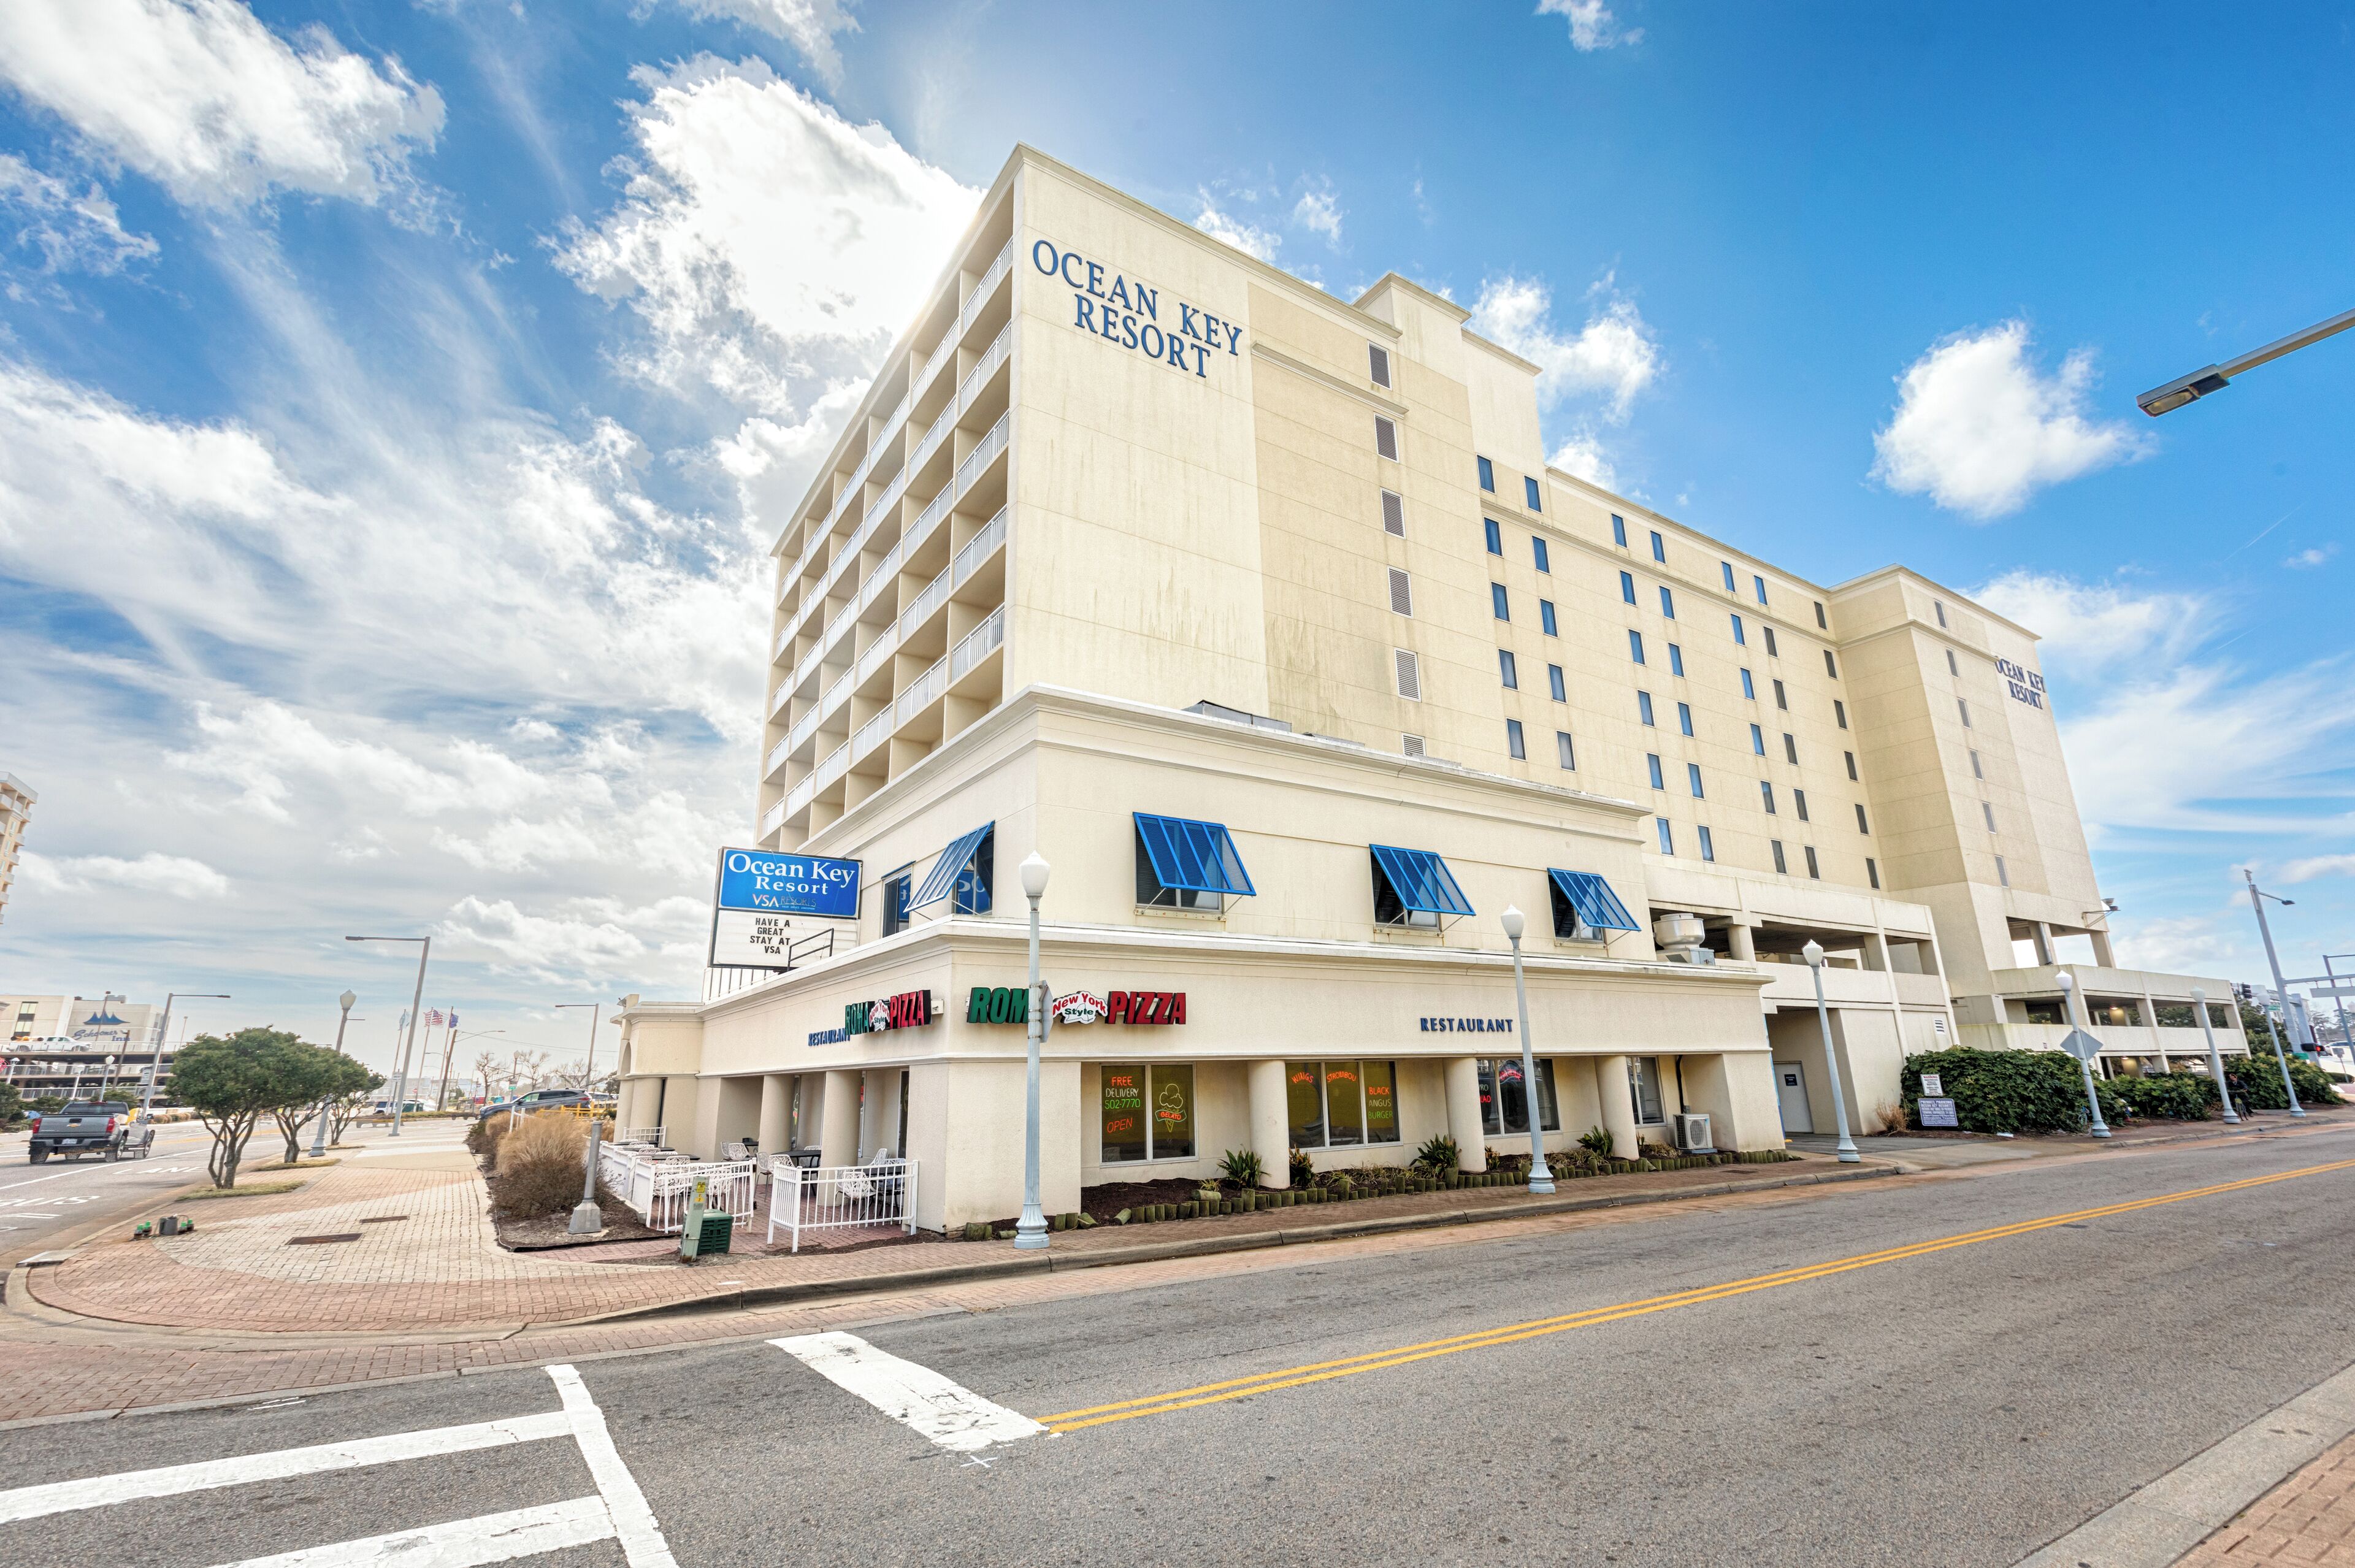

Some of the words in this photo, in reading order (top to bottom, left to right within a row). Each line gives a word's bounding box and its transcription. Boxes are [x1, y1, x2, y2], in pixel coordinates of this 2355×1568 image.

[1033, 240, 1158, 321] OCEAN
[1179, 302, 1243, 356] KEY
[1074, 293, 1211, 378] RESORT
[1994, 656, 2026, 684] OCEAN
[2027, 670, 2046, 693] KEY
[2007, 679, 2043, 709] RESORT
[728, 854, 804, 878] Ocean
[810, 861, 856, 889] Key
[754, 876, 828, 895] Resort
[752, 893, 779, 908] VSA
[781, 895, 816, 907] RESORTS
[756, 917, 779, 927] HAVE
[757, 927, 784, 936] GREAT
[750, 936, 772, 944] STAY
[764, 946, 781, 954] VSA
[890, 990, 925, 1030] PIZZA
[967, 987, 1029, 1023] ROM
[1052, 996, 1078, 1015] New
[1081, 993, 1106, 1014] York
[1105, 991, 1186, 1025] PIZZA
[870, 1005, 879, 1023] New
[1064, 1008, 1094, 1017] Style
[1420, 1017, 1513, 1032] RESTAURANT
[1111, 1076, 1133, 1087] FREE
[1292, 1072, 1314, 1084] WINGS
[1105, 1088, 1139, 1098] DELIVERY
[1369, 1087, 1389, 1095] BLACK
[1105, 1098, 1141, 1109] 502-7770
[1160, 1111, 1181, 1120] GELATO
[1368, 1111, 1393, 1119] BURGER
[1107, 1117, 1133, 1133] OPEN
